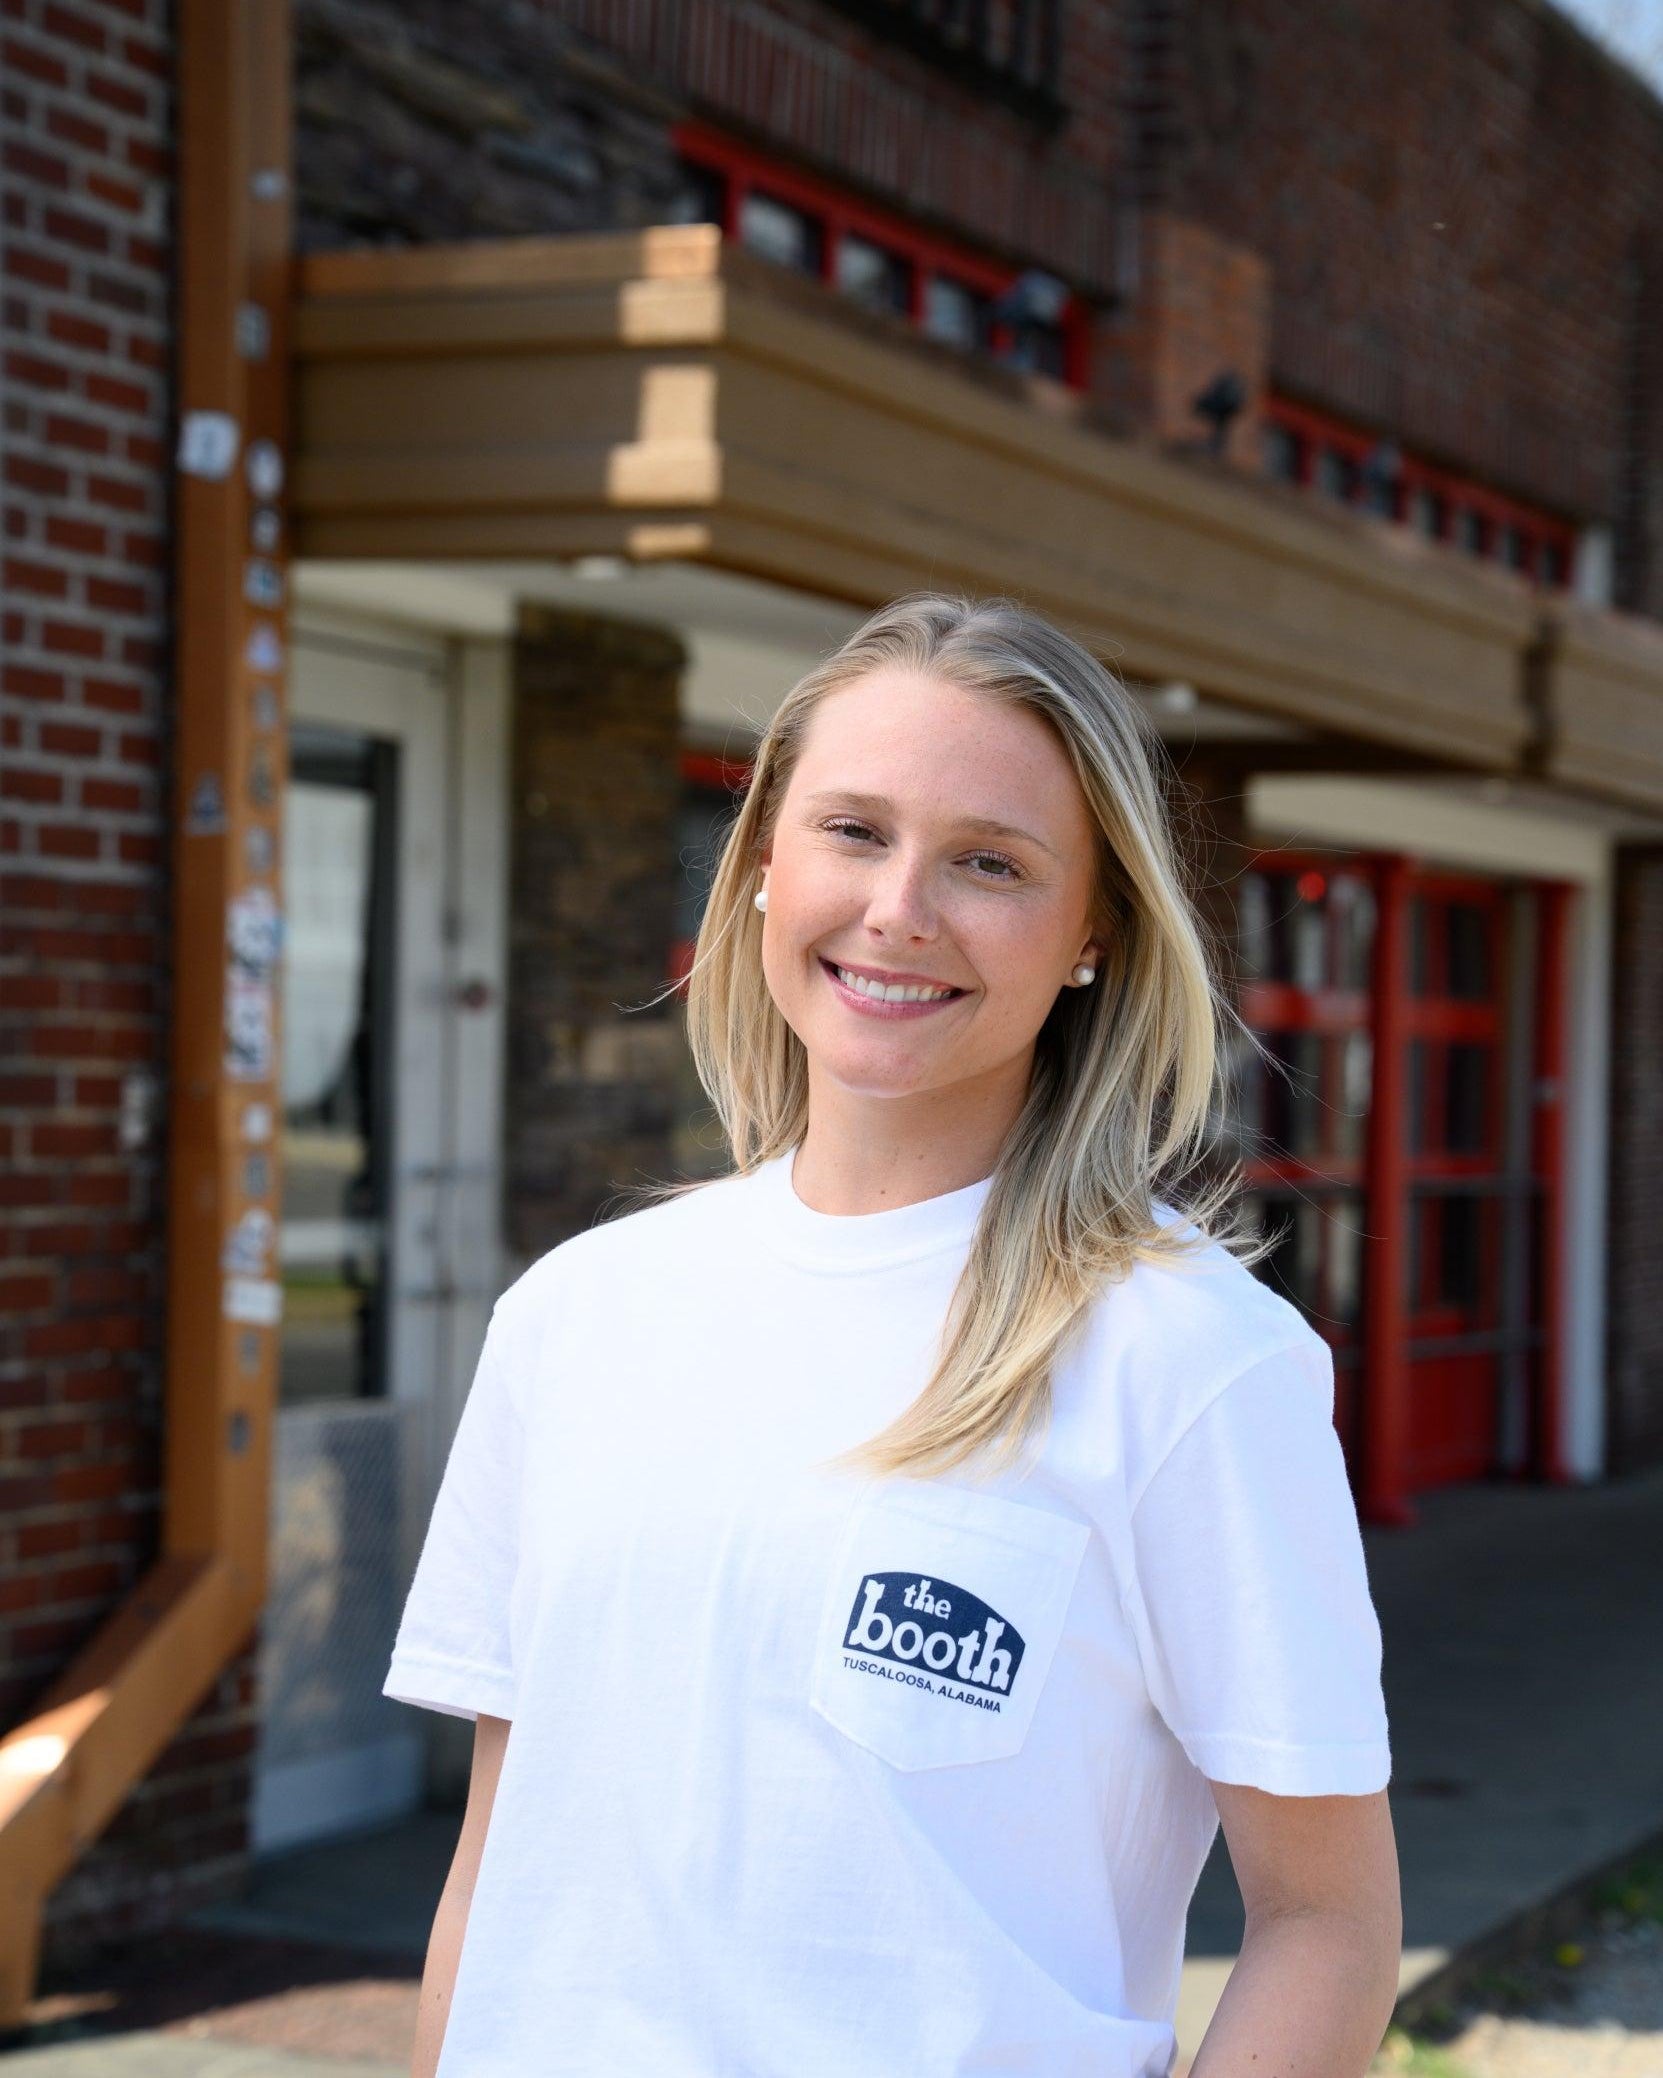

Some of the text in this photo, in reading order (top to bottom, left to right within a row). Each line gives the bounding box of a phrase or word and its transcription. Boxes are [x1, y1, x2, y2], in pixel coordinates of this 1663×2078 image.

[903, 1579, 952, 1620] the
[848, 1579, 1012, 1691] booth
[843, 1657, 1001, 1713] TUSCALOOSA, ALABAMA
